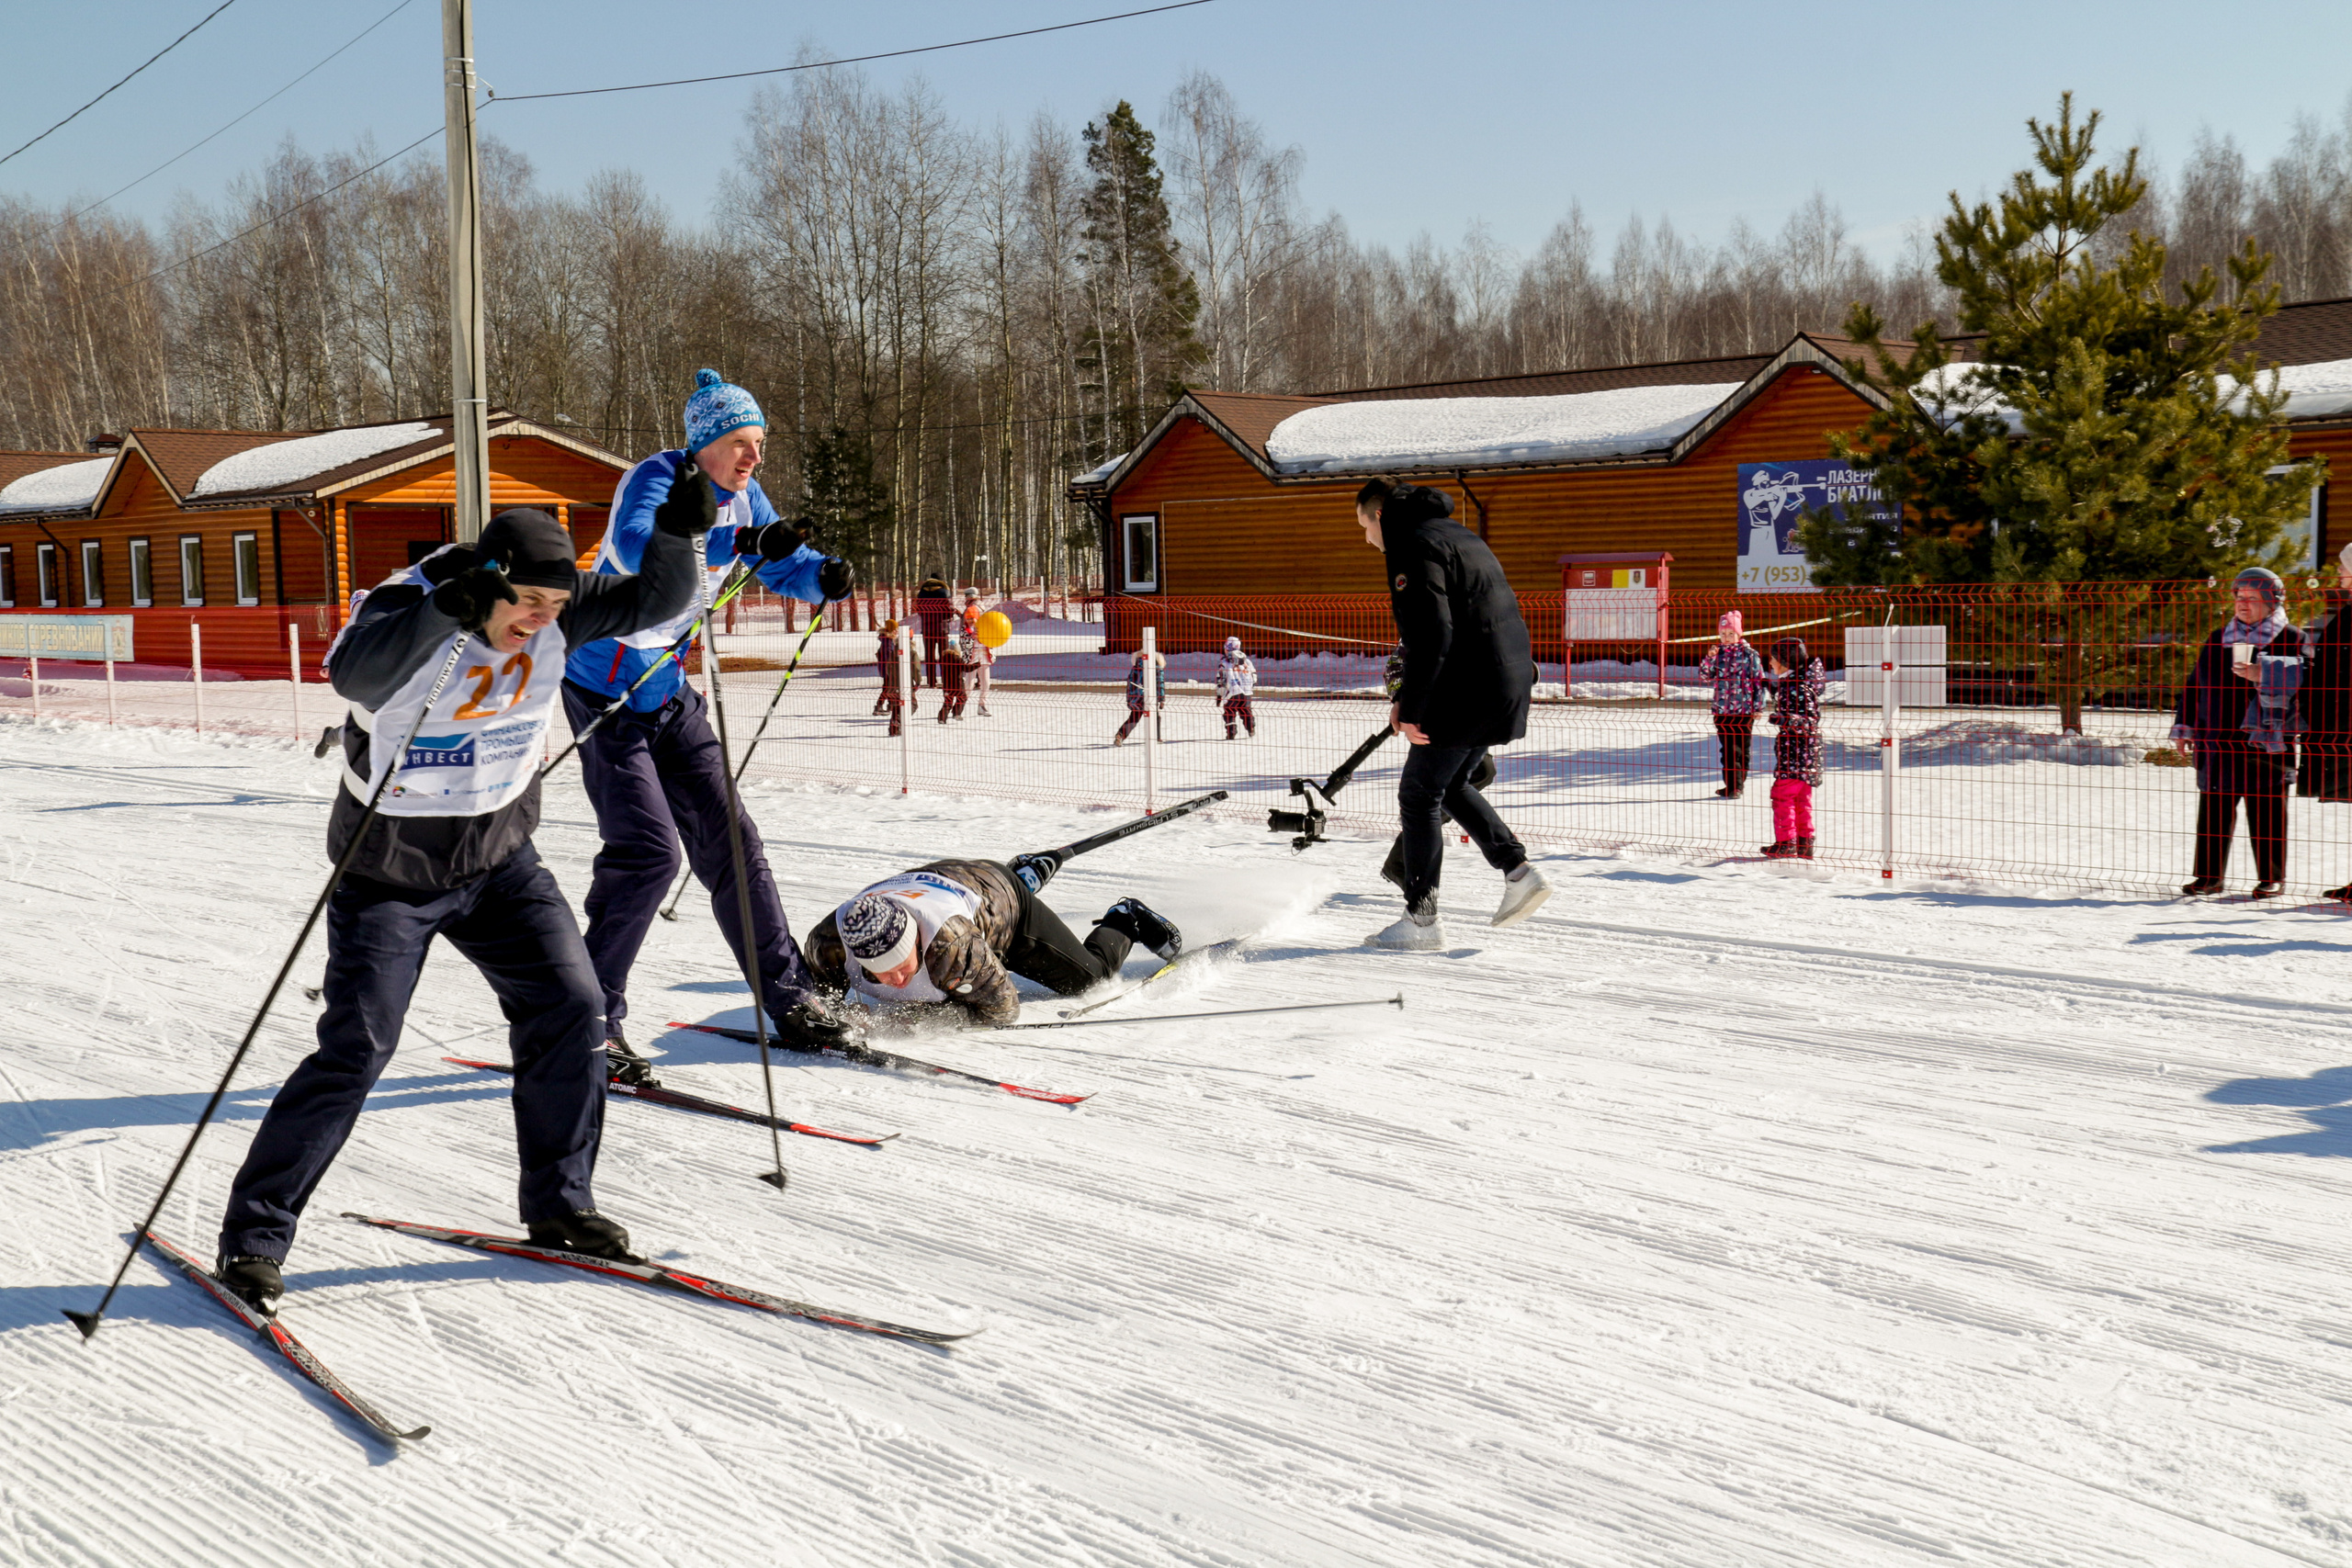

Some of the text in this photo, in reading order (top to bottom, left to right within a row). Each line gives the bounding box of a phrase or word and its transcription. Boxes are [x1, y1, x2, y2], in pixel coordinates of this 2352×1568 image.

[721, 412, 760, 430] SOCHI
[1827, 468, 1881, 484] ЛАЗЕРН
[1827, 485, 1893, 503] БИАТЛ
[1742, 565, 1806, 586] +7 (953)
[28, 619, 105, 653] СОРЕВНОВАНИЙ
[427, 655, 457, 705] NORDWAY
[608, 1082, 638, 1095] ATOMIC
